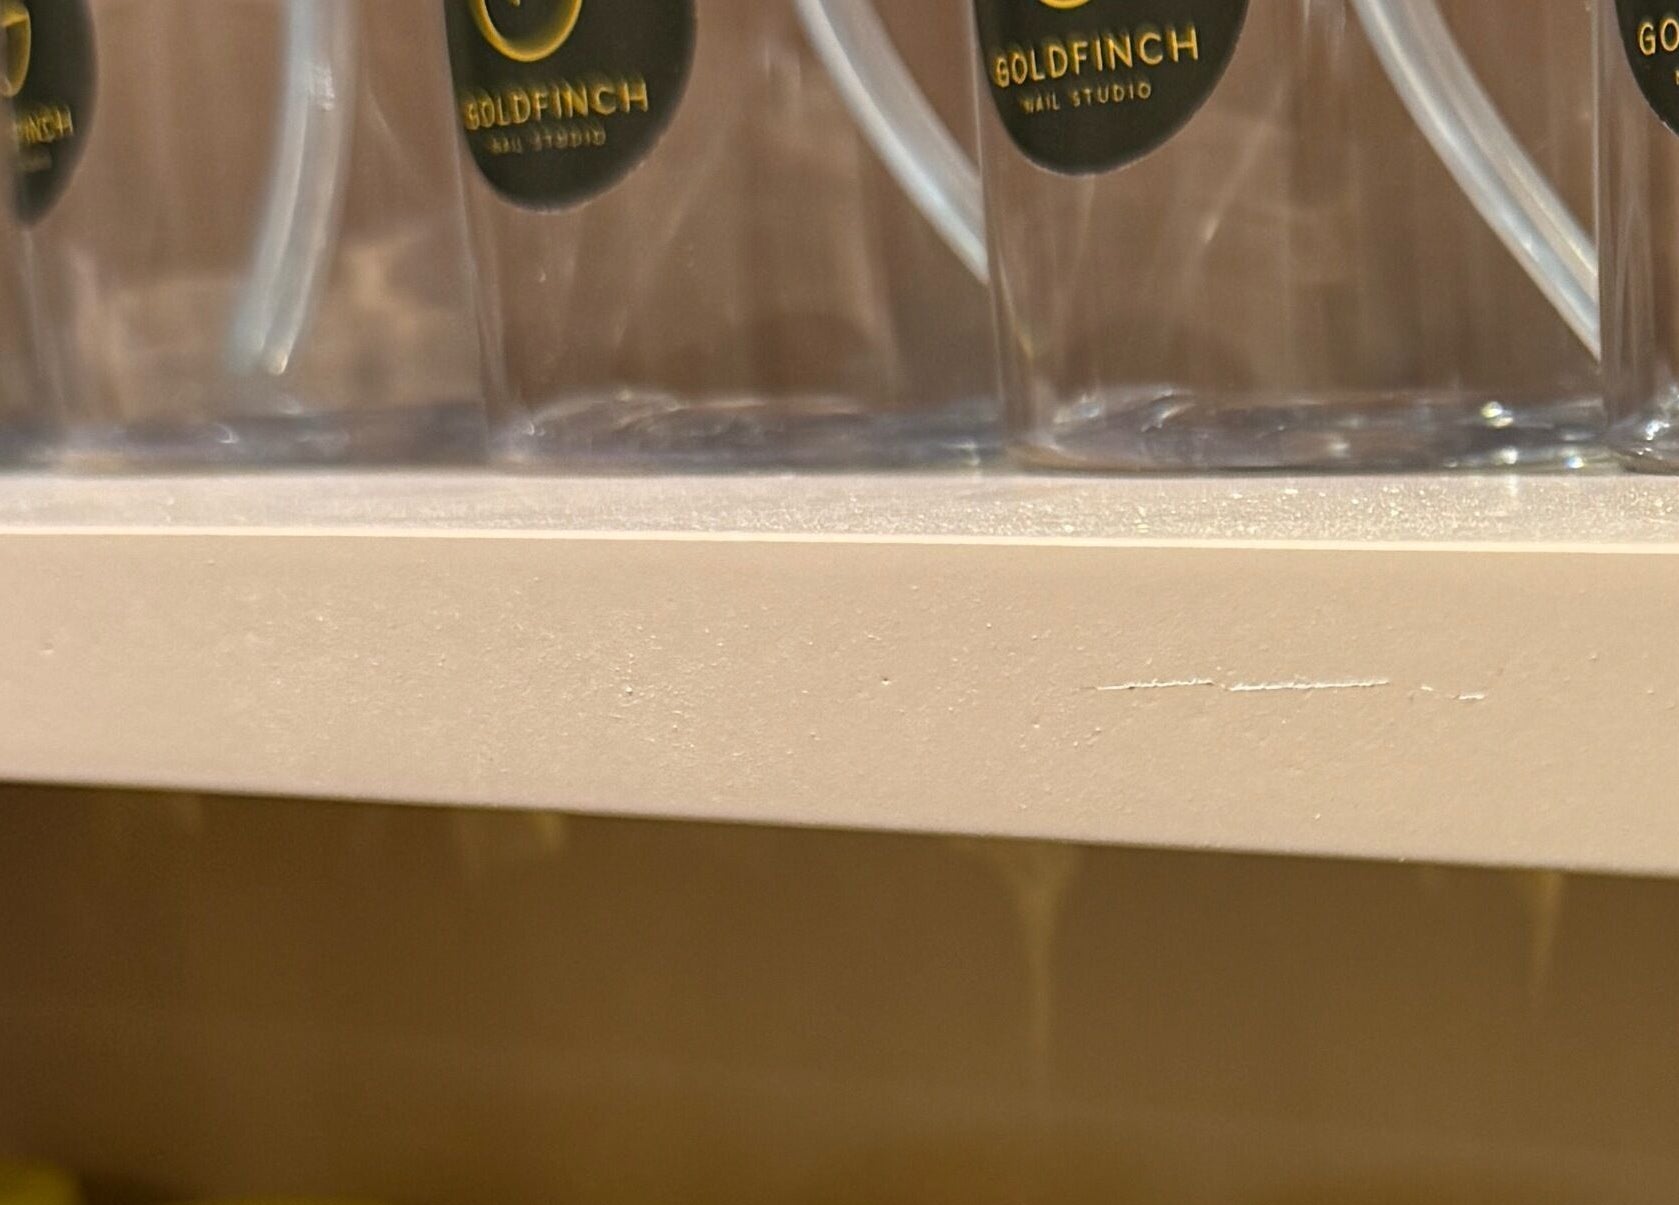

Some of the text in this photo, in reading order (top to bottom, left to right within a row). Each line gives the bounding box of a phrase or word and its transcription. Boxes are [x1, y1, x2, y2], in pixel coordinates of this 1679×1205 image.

[993, 25, 1199, 88] GOLDFINCH
[464, 78, 648, 131] GOLDFINCH
[1071, 82, 1153, 108] STUDIO
